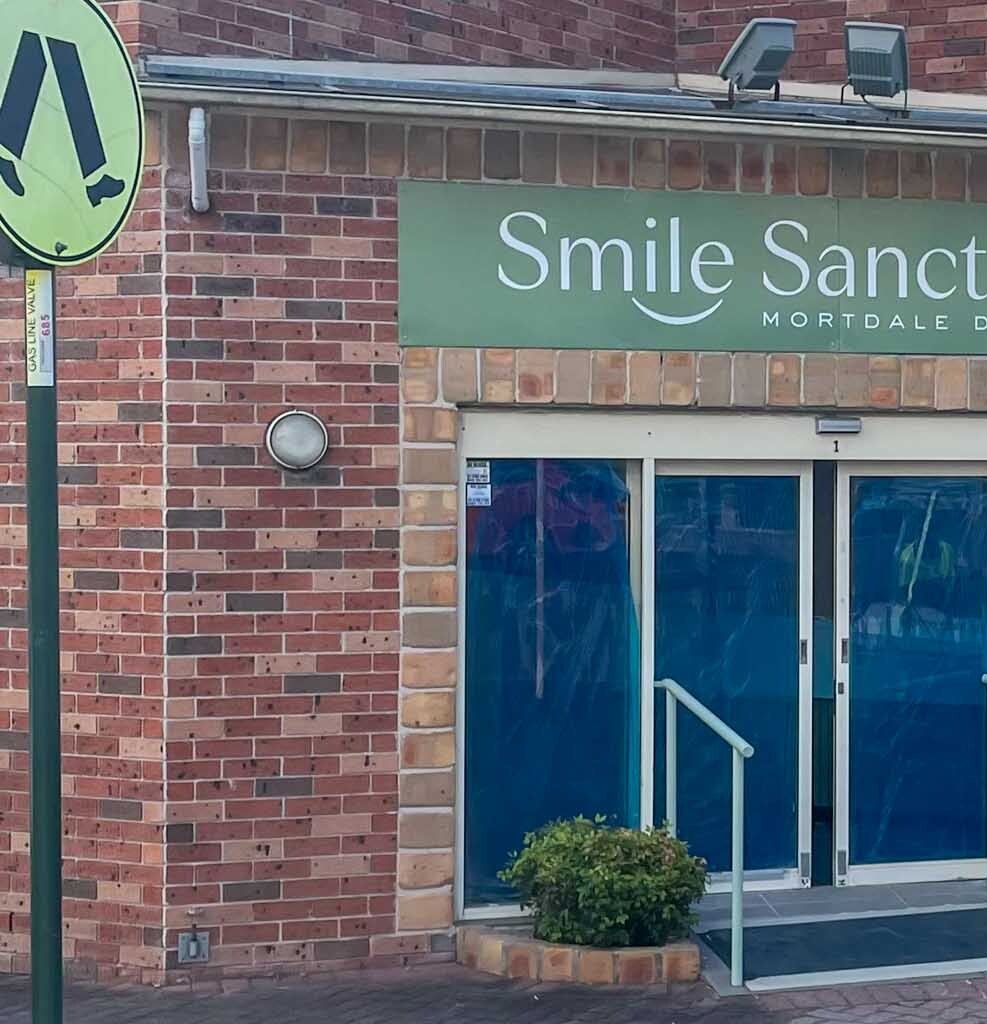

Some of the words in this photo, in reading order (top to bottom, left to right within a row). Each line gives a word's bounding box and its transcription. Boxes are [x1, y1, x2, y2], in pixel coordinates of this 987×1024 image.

[498, 211, 735, 295] Smile
[27, 278, 37, 315] VALVE
[28, 319, 37, 344] LINE
[762, 311, 950, 330] MORTDALE
[28, 346, 37, 372] GAS
[833, 440, 839, 453] 1
